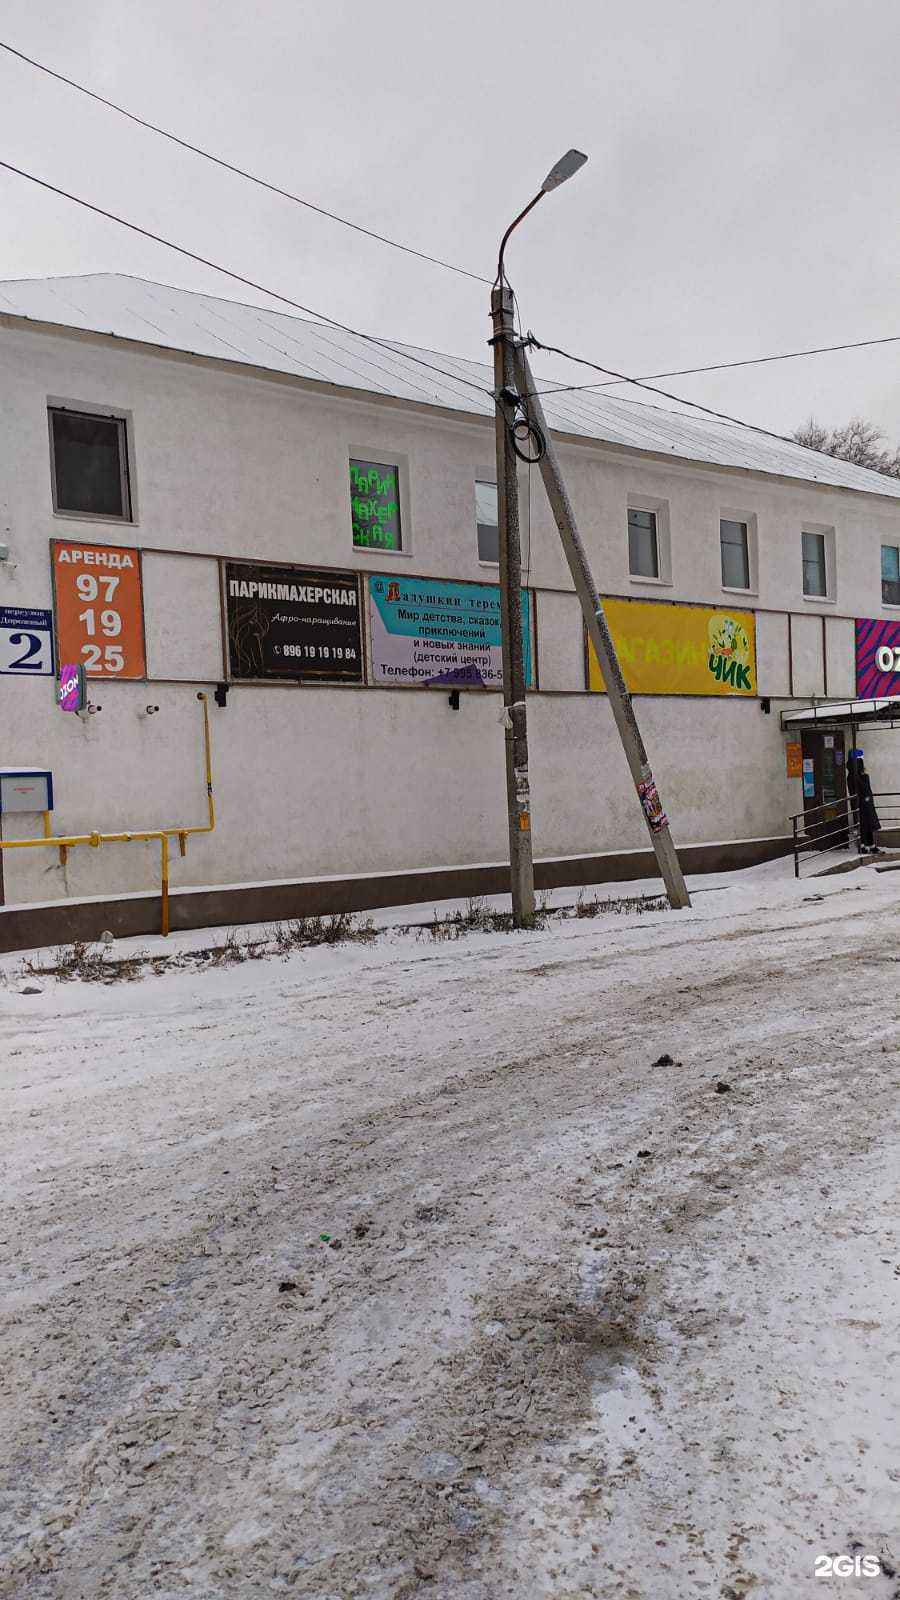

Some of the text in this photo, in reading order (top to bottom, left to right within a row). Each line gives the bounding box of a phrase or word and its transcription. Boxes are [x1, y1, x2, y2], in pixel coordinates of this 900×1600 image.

[58, 550, 134, 570] АРЕНДА
[76, 574, 119, 602] 97
[229, 579, 357, 606] ПАРИКМАХЕРСКАЯ
[468, 599, 501, 609] тере
[79, 609, 122, 637] 19
[398, 608, 419, 621] Мир
[423, 611, 465, 625] детства,
[8, 633, 43, 669] 2
[283, 645, 357, 659] 896 19 19 19 84
[413, 639, 420, 648] и
[423, 640, 455, 650] новых
[80, 644, 125, 673] 25
[413, 651, 491, 667] (детский центр)
[614, 637, 752, 690] АГАЗИН ЧИК
[381, 664, 434, 677] Телефон:
